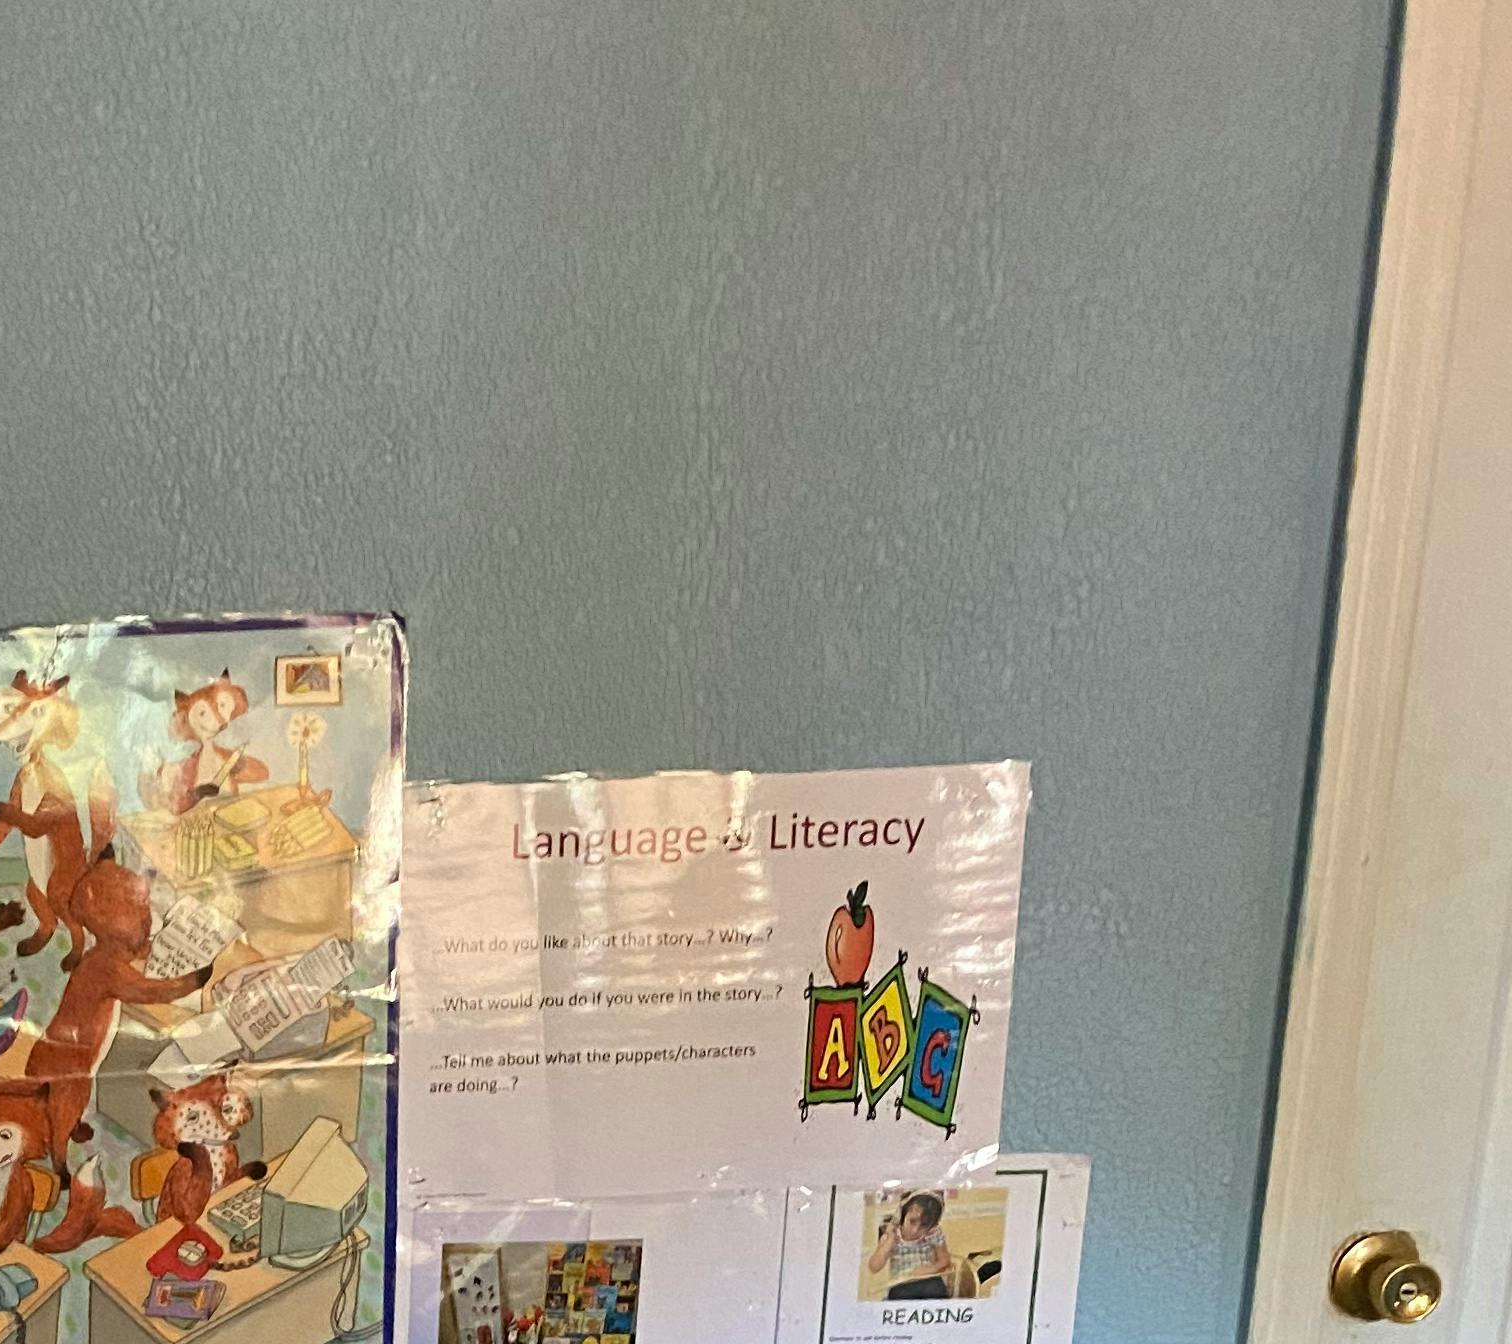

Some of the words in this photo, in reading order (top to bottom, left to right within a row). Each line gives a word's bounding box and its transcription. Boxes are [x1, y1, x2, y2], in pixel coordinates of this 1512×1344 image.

[512, 823, 707, 865] Language
[769, 812, 926, 855] Literacy
[489, 939, 508, 951] do
[512, 939, 537, 954] you
[543, 934, 568, 950] like
[572, 934, 616, 949] about
[621, 933, 652, 948] that
[488, 994, 533, 1010] would
[538, 995, 564, 1010] you
[568, 991, 588, 1007] do
[591, 990, 602, 1006] if
[606, 992, 633, 1008] you
[638, 991, 674, 1004] were
[679, 987, 692, 1001] in
[696, 987, 721, 1001] the
[471, 1056, 493, 1067] me
[497, 1052, 540, 1067] about
[545, 1051, 581, 1065] what
[586, 1050, 611, 1063] the
[615, 1044, 757, 1067] puppets/characters
[430, 1080, 453, 1093] are
[882, 1308, 974, 1325] READING
